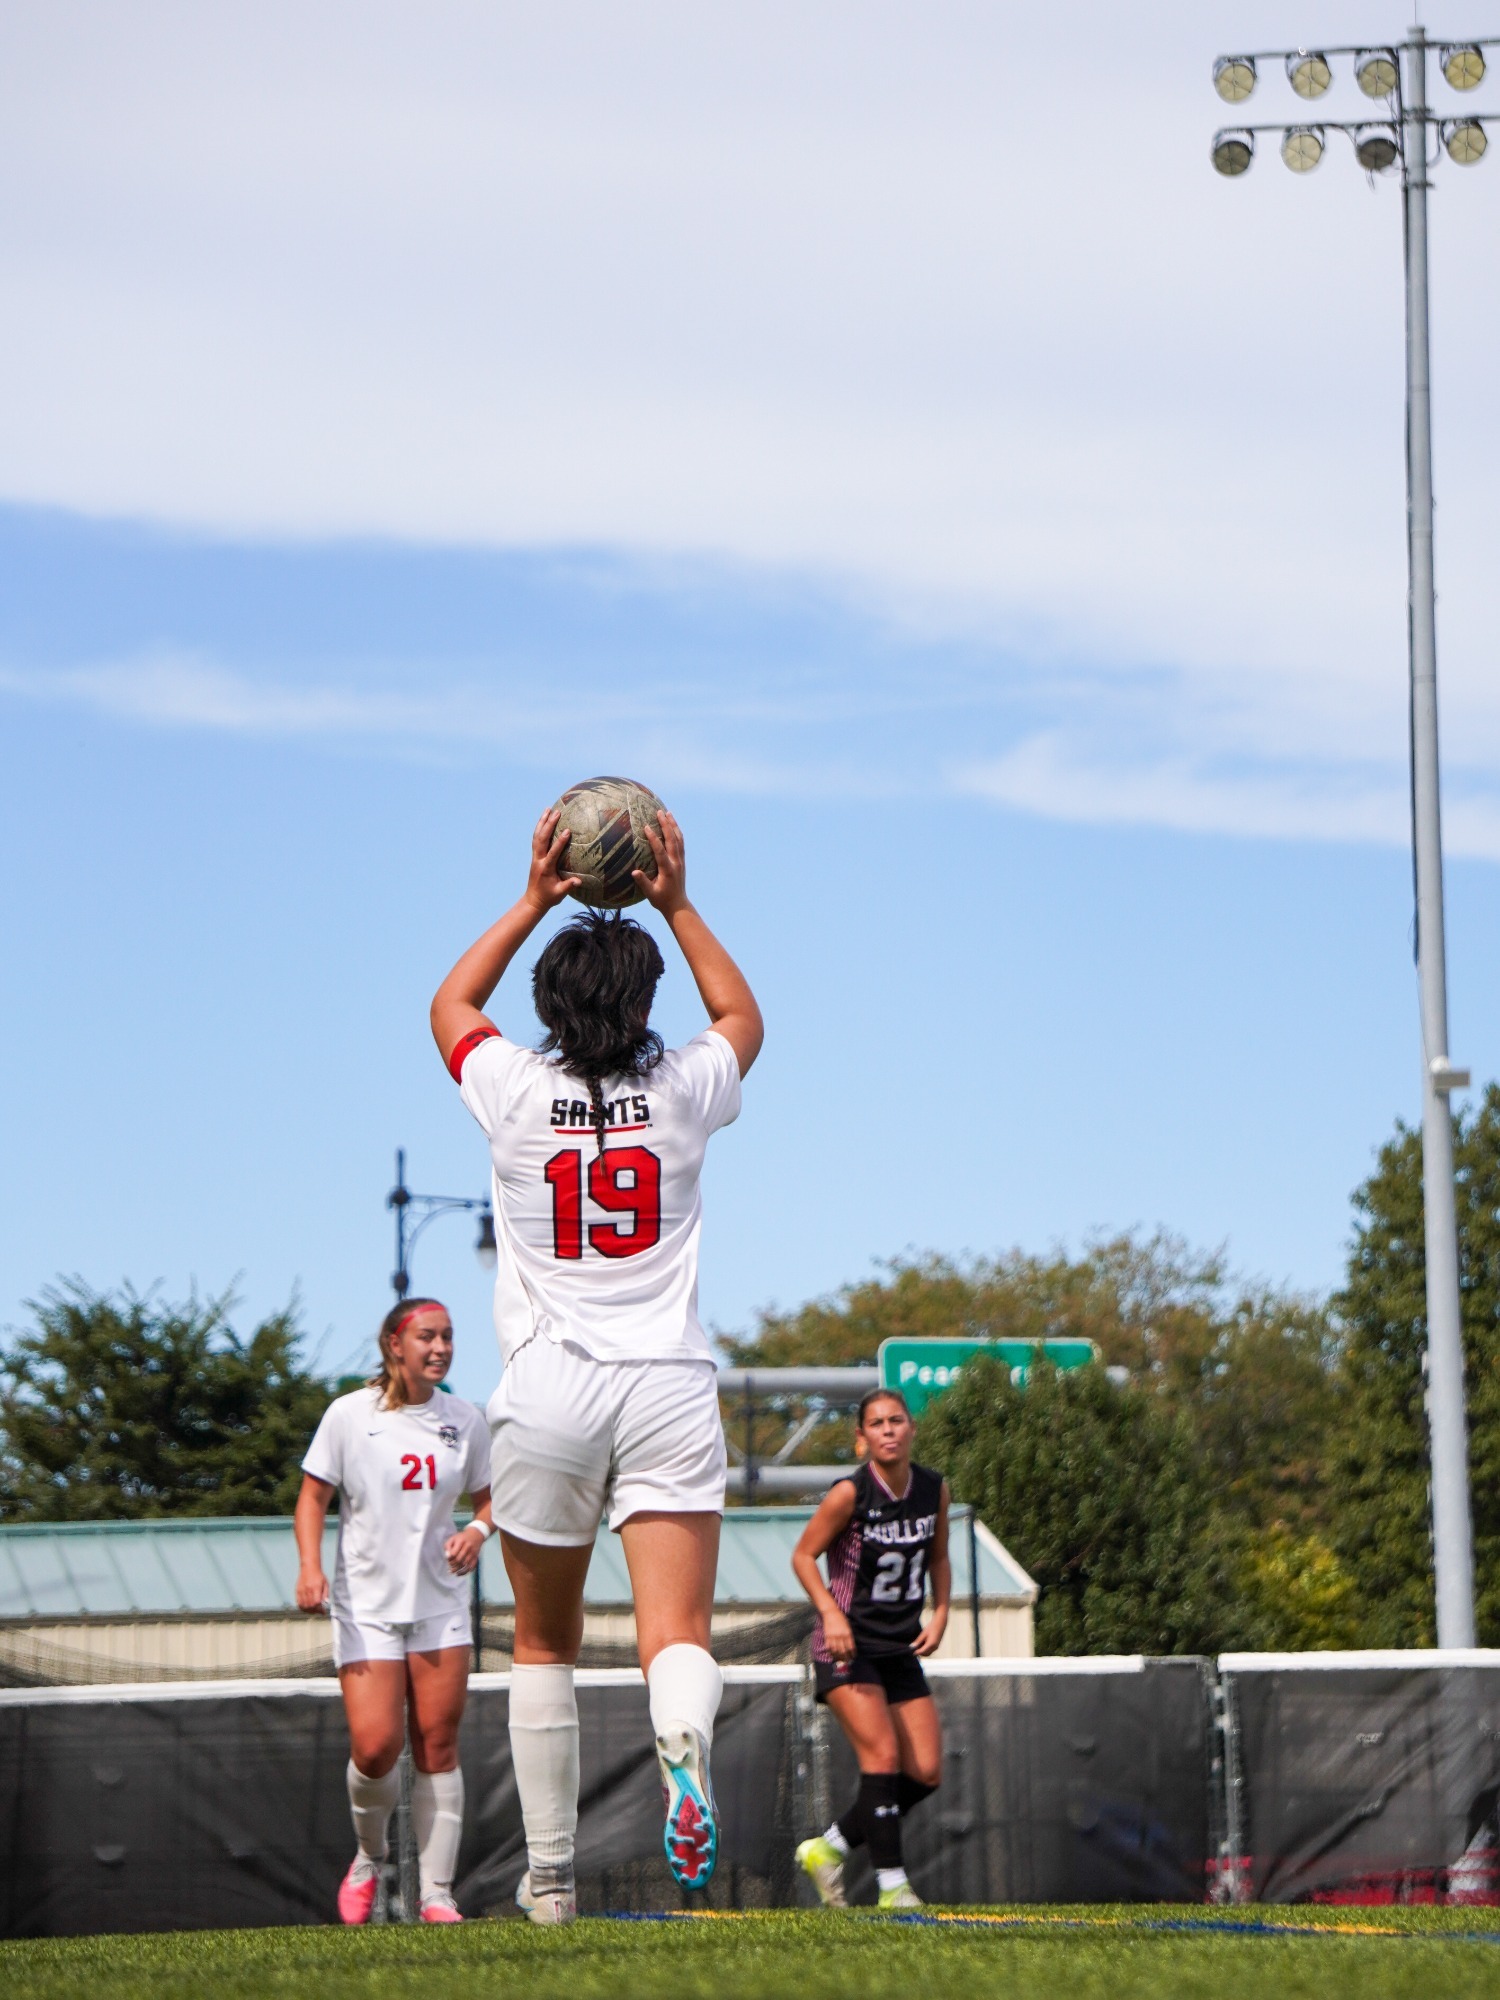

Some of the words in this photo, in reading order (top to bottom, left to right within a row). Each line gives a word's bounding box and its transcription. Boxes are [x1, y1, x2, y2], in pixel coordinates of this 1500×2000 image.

[544, 1145, 661, 1259] 19
[400, 1453, 438, 1490] 21
[871, 1548, 925, 1602] 21
